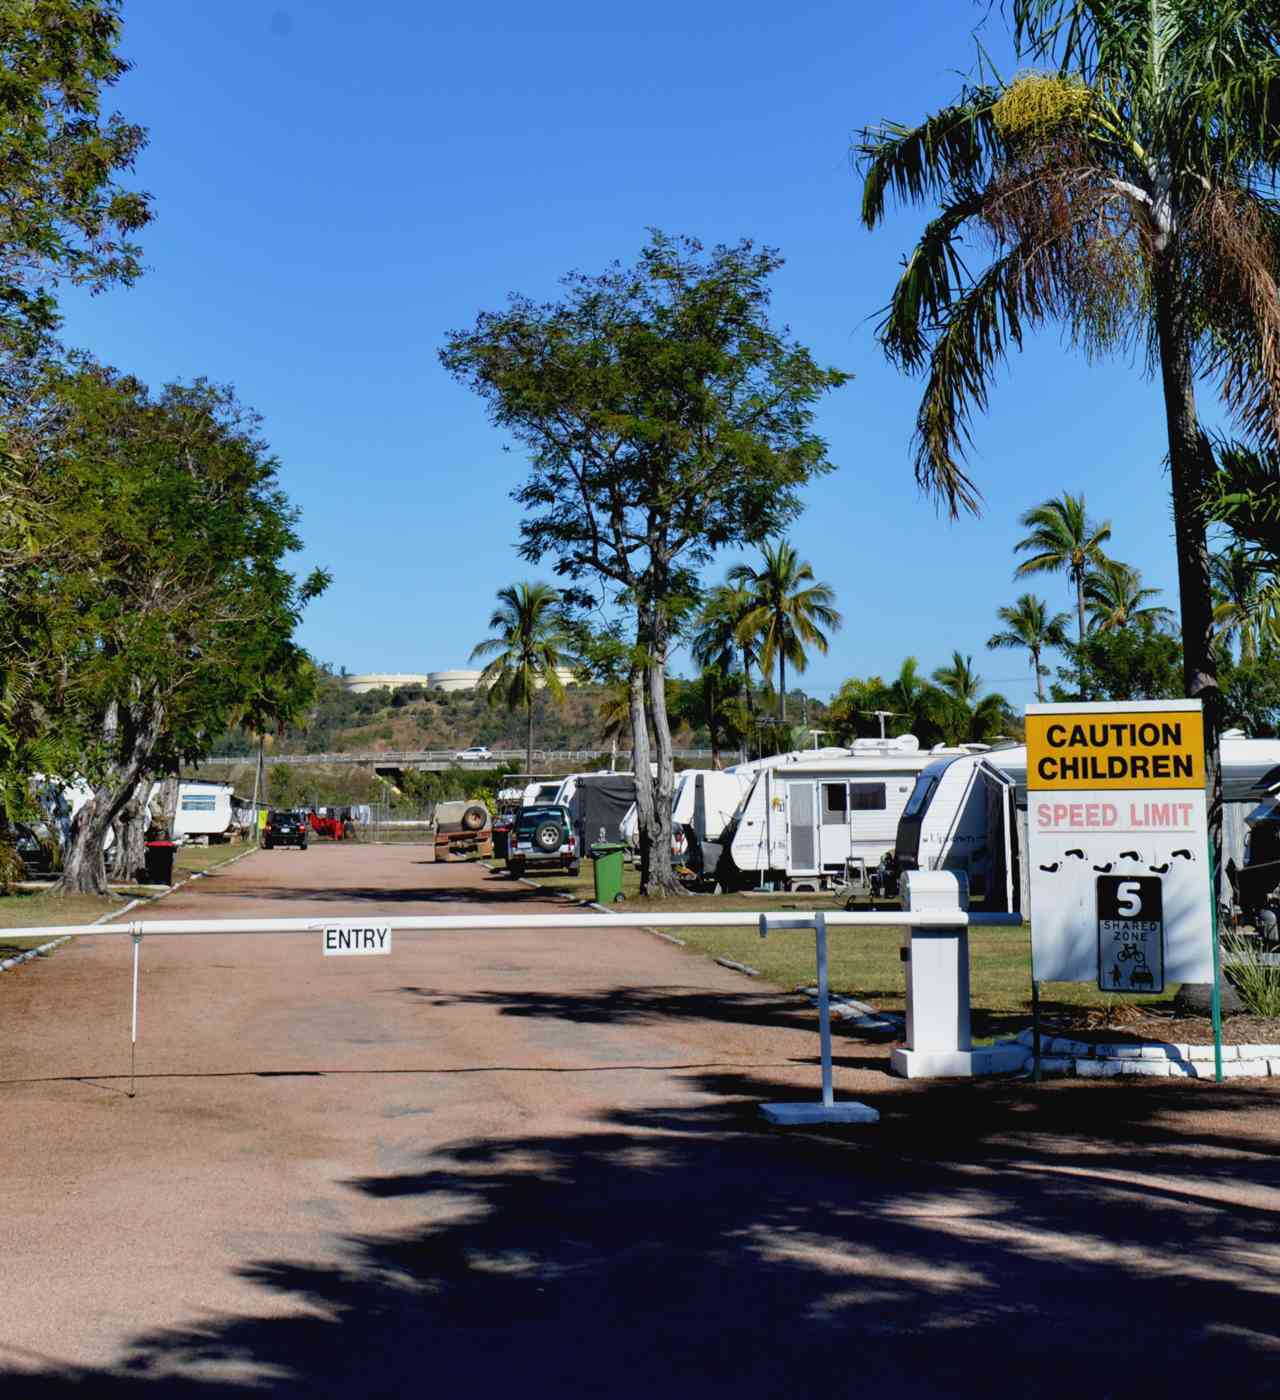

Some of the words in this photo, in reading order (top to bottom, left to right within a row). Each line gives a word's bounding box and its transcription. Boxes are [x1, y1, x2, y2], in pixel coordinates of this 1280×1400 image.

[1046, 723, 1182, 748] CAUTION
[1037, 754, 1193, 780] CHILDREN
[1037, 803, 1118, 827] SPEED
[1129, 802, 1194, 827] LIMIT
[1116, 881, 1142, 918] 5
[1103, 919, 1158, 931] SHARED
[1113, 931, 1148, 941] ZONE
[325, 928, 387, 949] ENTRY
